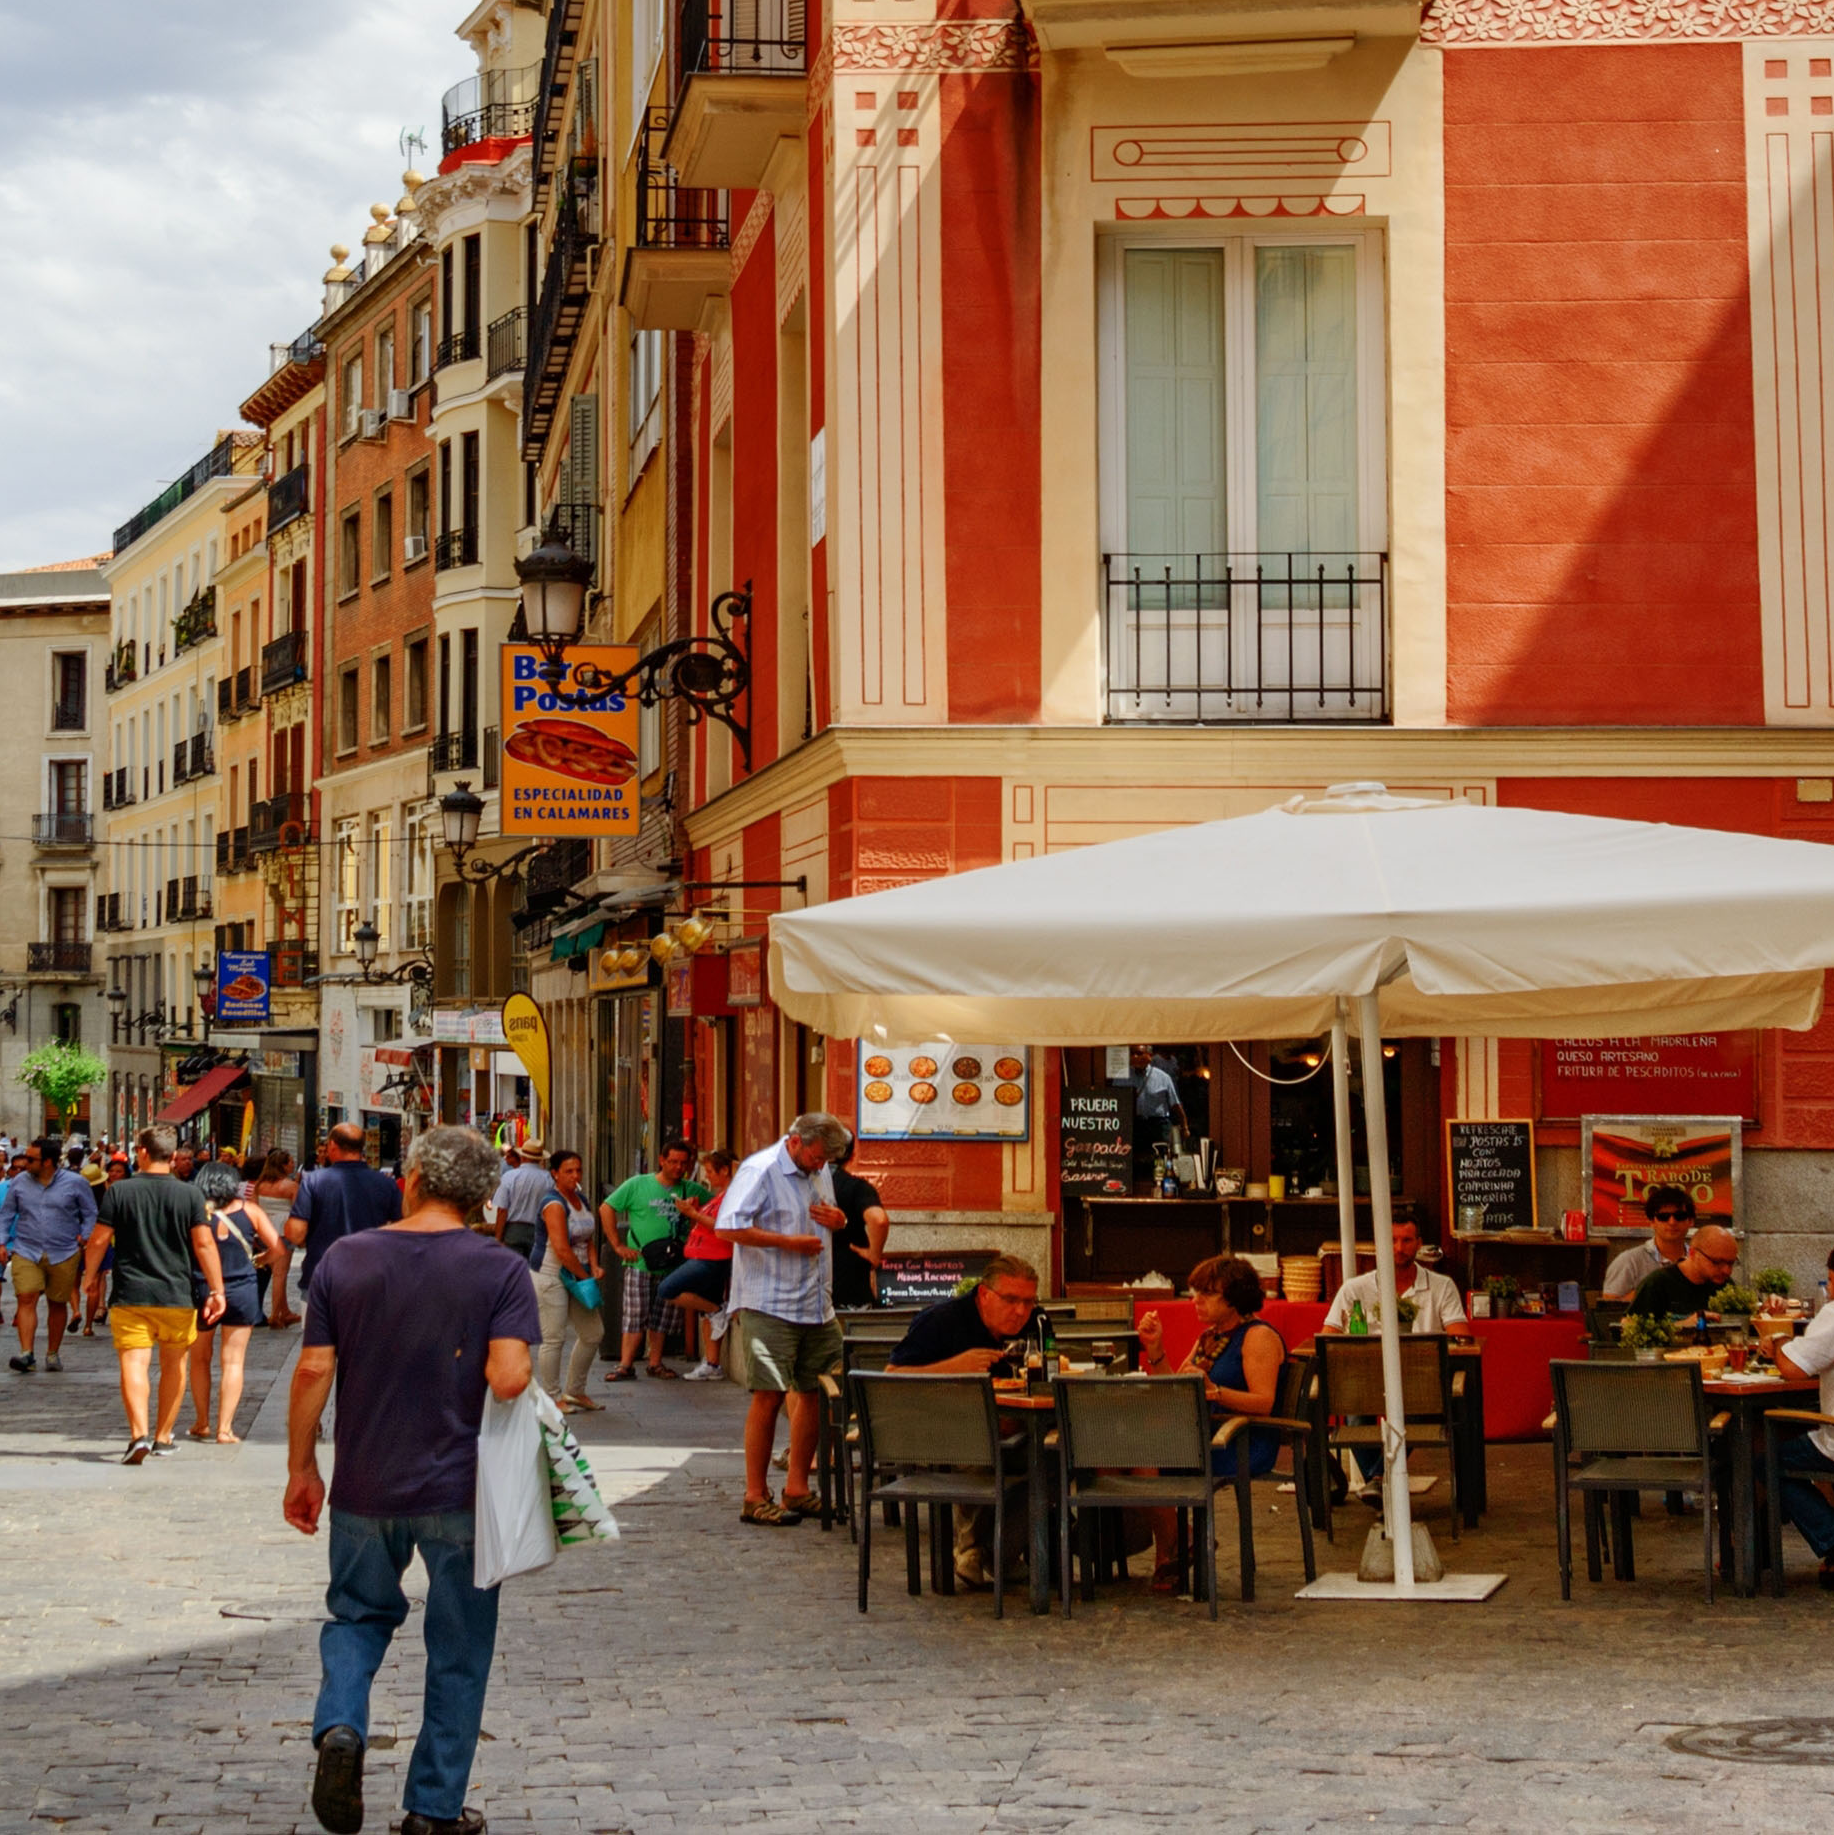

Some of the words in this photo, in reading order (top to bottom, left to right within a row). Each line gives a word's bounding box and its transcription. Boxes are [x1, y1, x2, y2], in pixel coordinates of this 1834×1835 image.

[513, 685, 626, 713] Postas
[513, 788, 623, 801] ESPECIALIDAD
[513, 807, 532, 820] EN
[537, 807, 630, 820] CALAMARES
[1555, 1037, 1604, 1048] CALLOS
[1624, 1037, 1641, 1047] LA
[1650, 1035, 1717, 1048] MADRILEÑA
[1556, 1051, 1593, 1062] QUESO
[1600, 1051, 1660, 1062] ARTESANO
[1557, 1065, 1604, 1078] FRITURA
[1607, 1066, 1621, 1078] DE
[1625, 1065, 1695, 1078] PESCADITOS
[1070, 1097, 1118, 1112] PRUEBA
[1061, 1116, 1120, 1131] NUESTRO
[1064, 1136, 1132, 1162] Gazpacho
